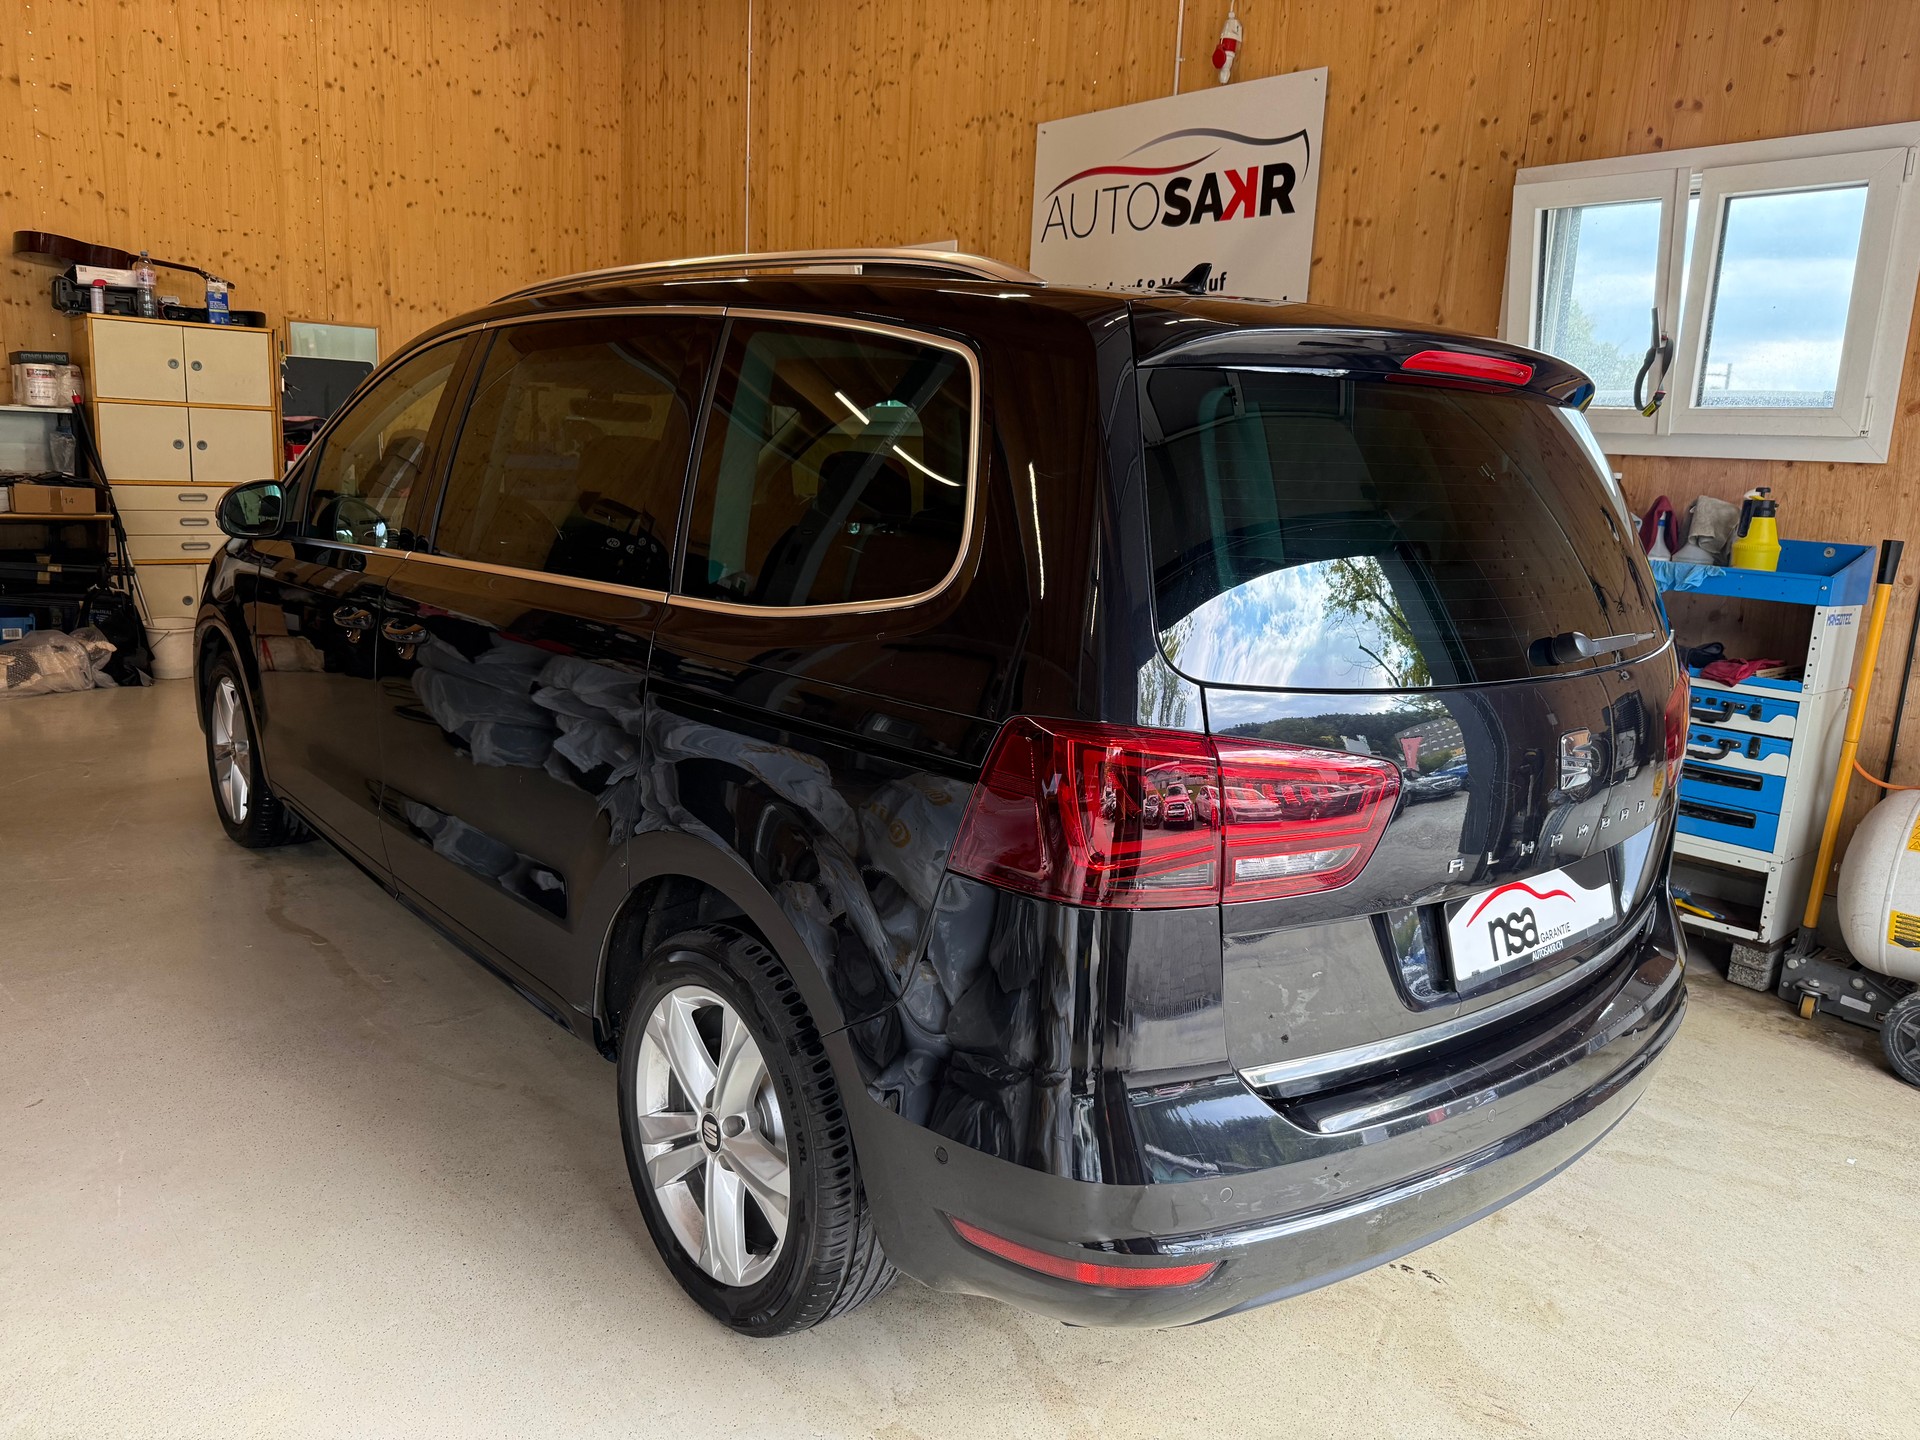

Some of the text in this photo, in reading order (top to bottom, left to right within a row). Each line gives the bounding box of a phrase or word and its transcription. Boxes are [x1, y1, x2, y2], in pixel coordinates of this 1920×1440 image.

[1448, 801, 1646, 873] ALHAMBRA
[1487, 906, 1540, 961] nsa
[1540, 921, 1571, 943] GARANTIE
